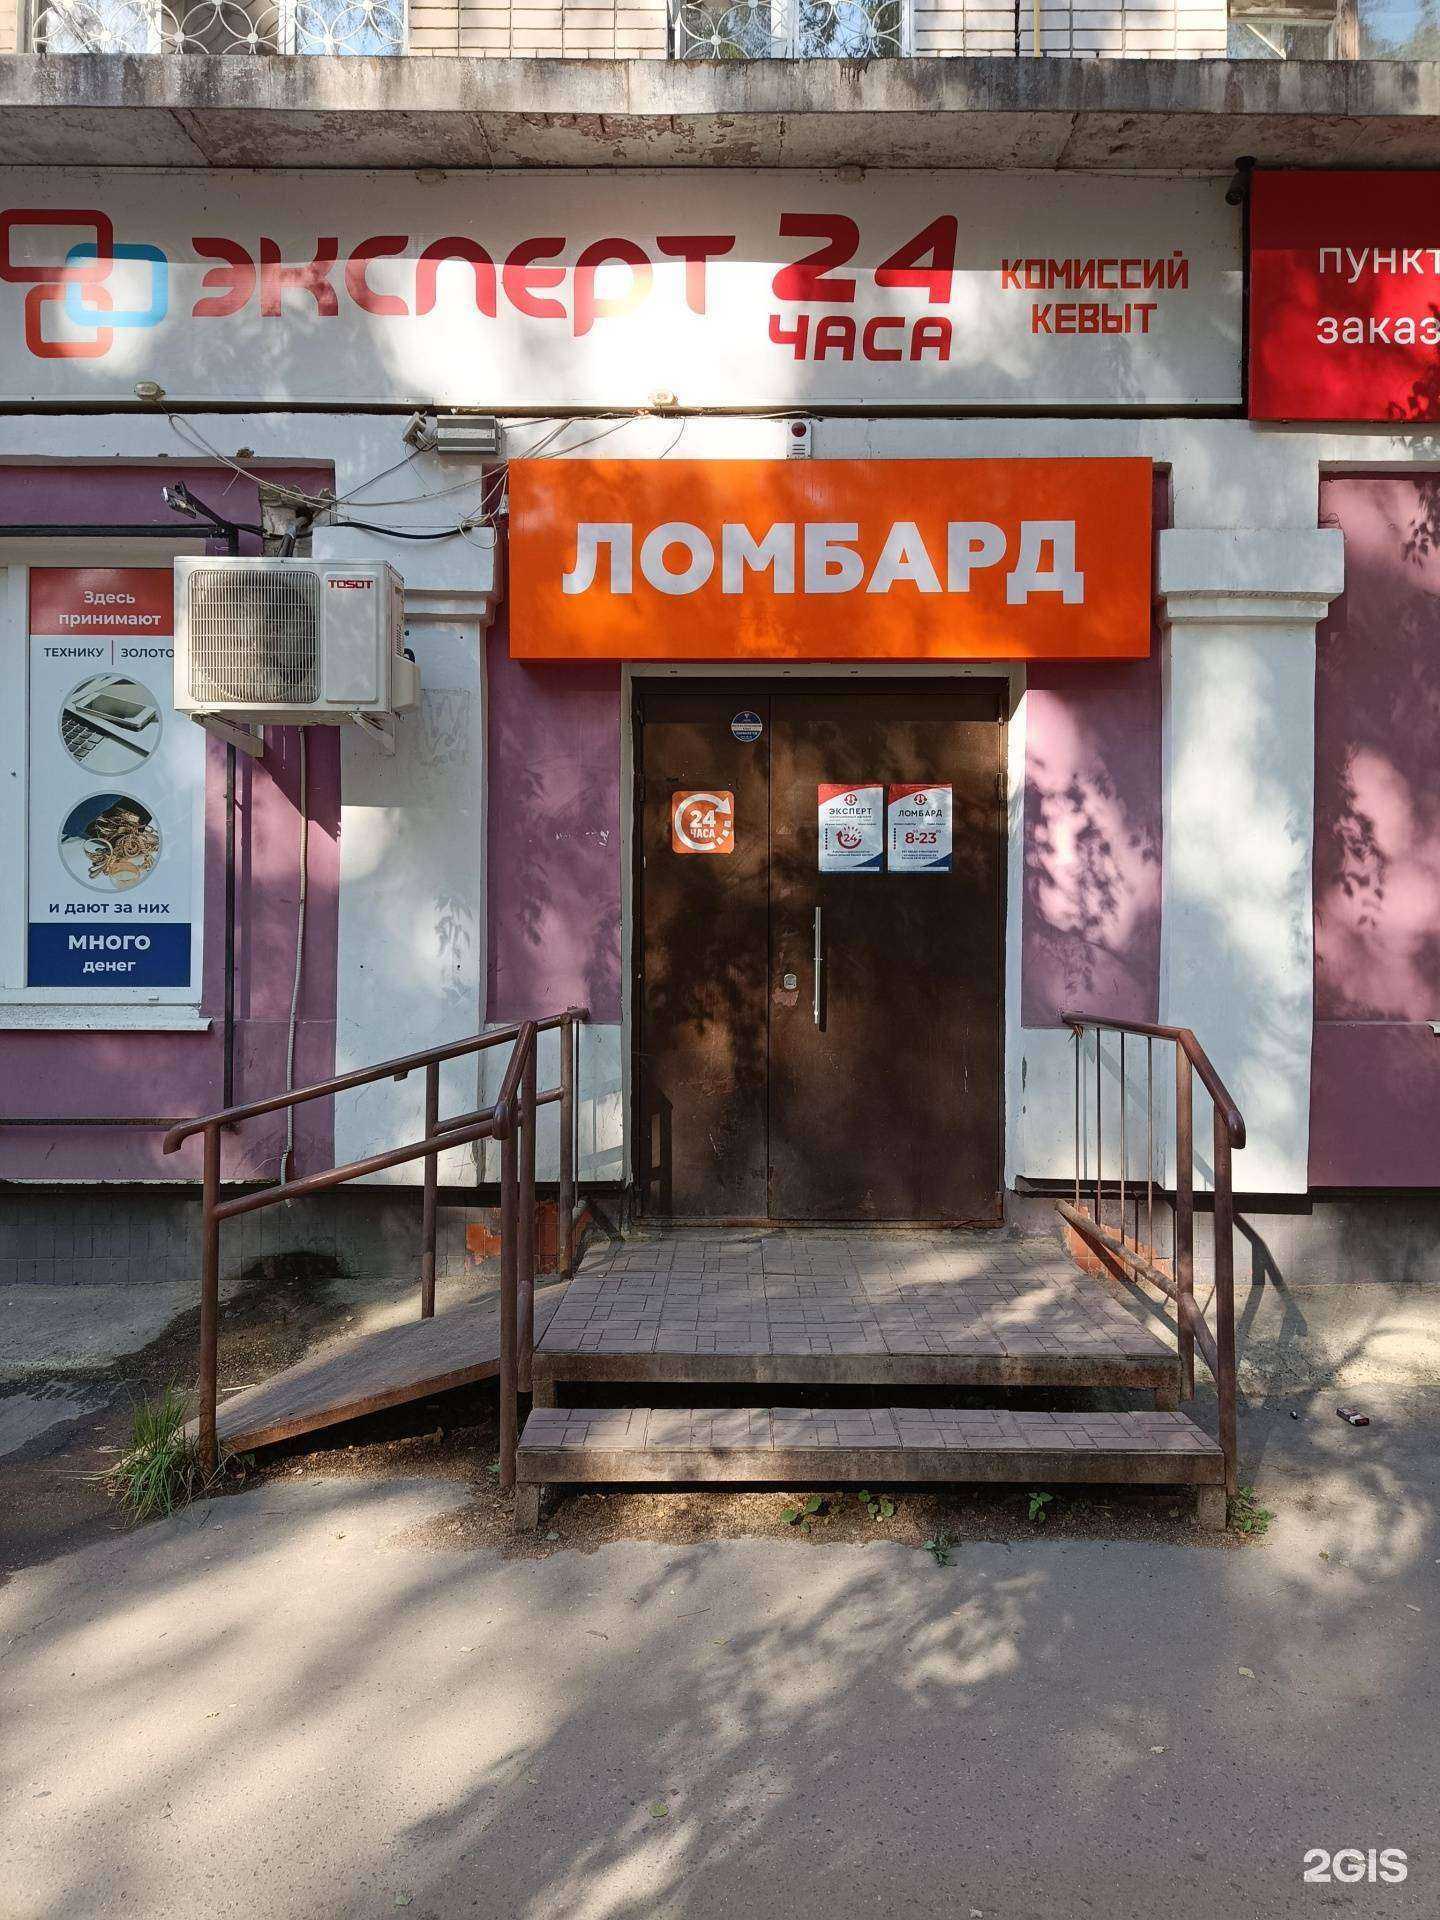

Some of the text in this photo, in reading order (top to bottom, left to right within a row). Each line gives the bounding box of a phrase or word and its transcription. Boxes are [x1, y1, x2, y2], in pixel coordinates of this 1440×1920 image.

[771, 212, 958, 304] 24
[1000, 250, 1189, 290] КОМИССИЙ
[1031, 303, 1158, 334] КЕВЫТ
[768, 314, 953, 361] ЧАСА
[562, 519, 1085, 605] ЛОМБАРД
[328, 579, 374, 589] TOSOT
[83, 590, 136, 606] Здесь
[59, 613, 162, 628] принимают
[43, 647, 175, 658] ТЕХНИКУ ЗОЛОТО
[828, 807, 873, 815] ЭКСПЕРТ
[898, 809, 943, 818] ЛОМБАРД
[690, 810, 717, 828] 24
[690, 828, 716, 839] ЧАСА
[49, 903, 170, 915] и дают за них
[82, 961, 136, 974] денег
